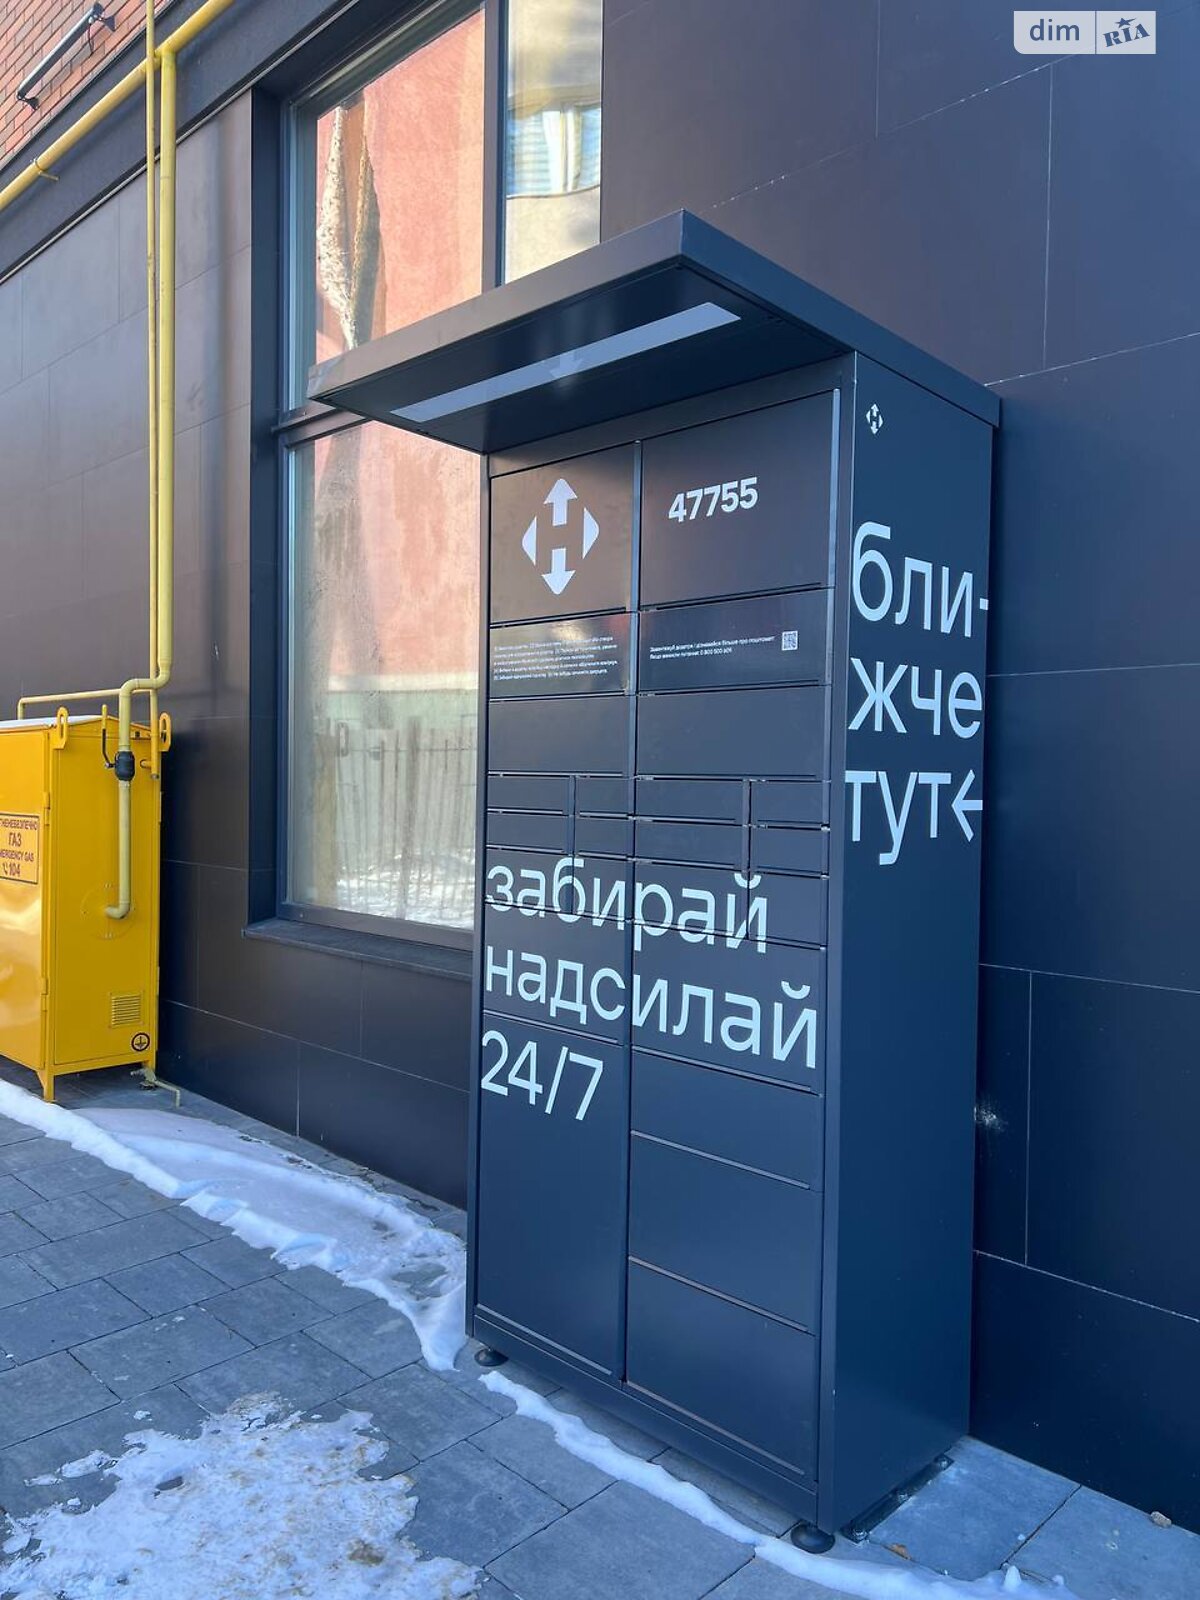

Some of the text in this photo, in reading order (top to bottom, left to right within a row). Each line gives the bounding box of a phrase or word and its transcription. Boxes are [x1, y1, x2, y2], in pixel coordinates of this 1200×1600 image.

[667, 476, 759, 522] 47755
[851, 521, 988, 638] бли-
[848, 657, 983, 739] жче
[9, 832, 22, 847] ГАЗ
[845, 770, 951, 865] тут
[486, 857, 768, 953] забирай
[486, 944, 817, 1069] надсилай
[481, 1029, 604, 1121] 24/7
